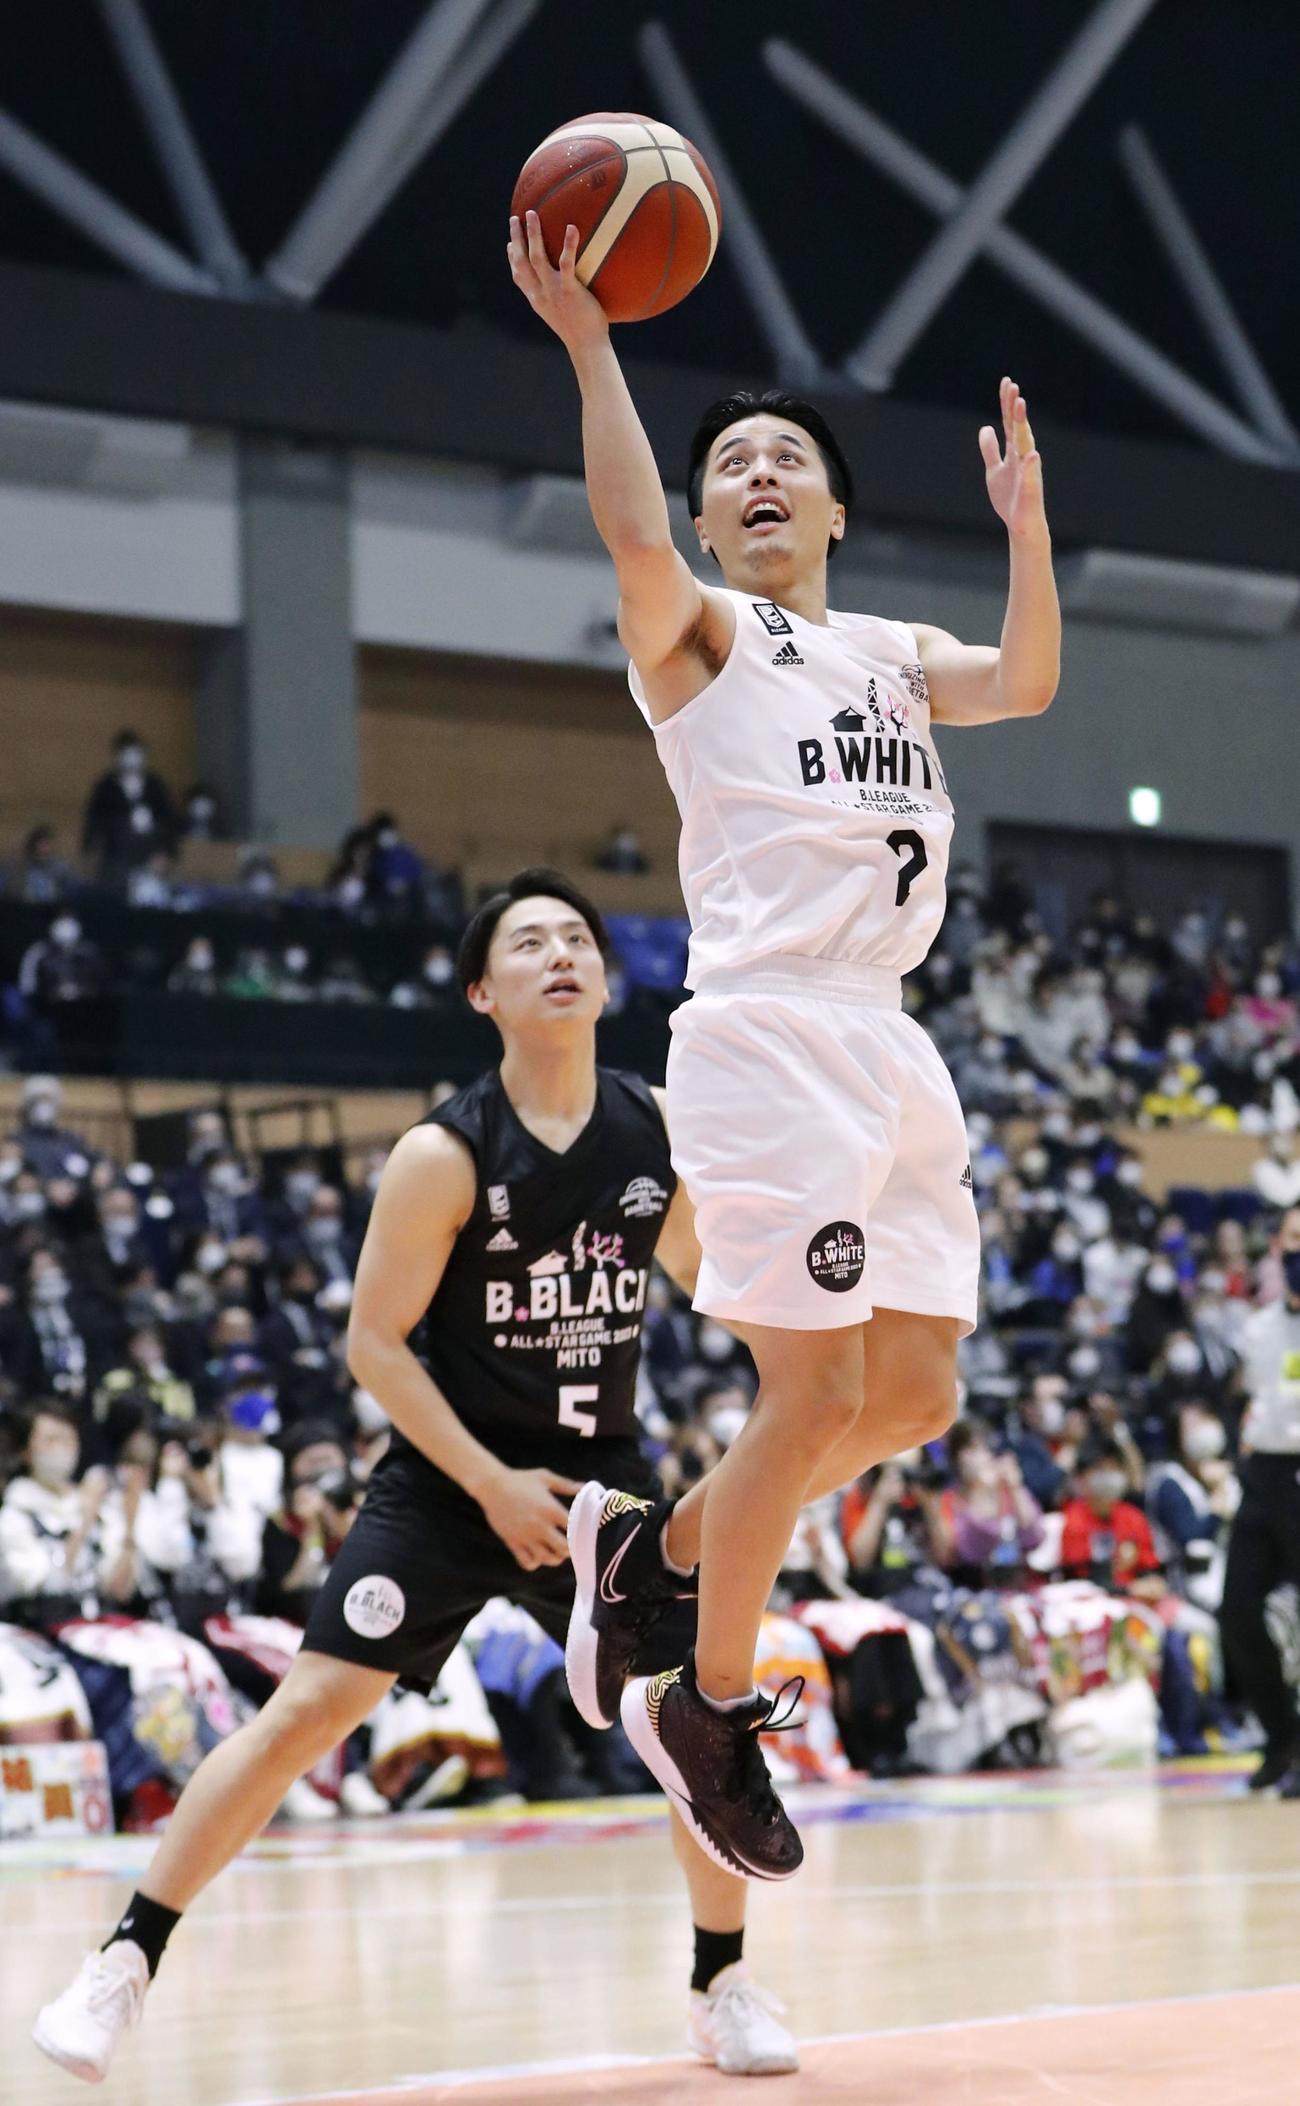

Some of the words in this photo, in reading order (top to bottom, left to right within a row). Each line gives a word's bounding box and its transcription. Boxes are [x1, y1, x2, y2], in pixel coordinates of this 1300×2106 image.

[772, 656, 805, 666] adidas
[797, 736, 949, 794] B.WHIT
[859, 788, 911, 803] B.LEAGUE
[890, 803, 924, 815] GAME
[811, 1245, 864, 1268] B.WHITE
[550, 1316, 605, 1336] B.LEAGUE
[557, 1346, 601, 1369] MITO
[558, 1384, 599, 1438] 5
